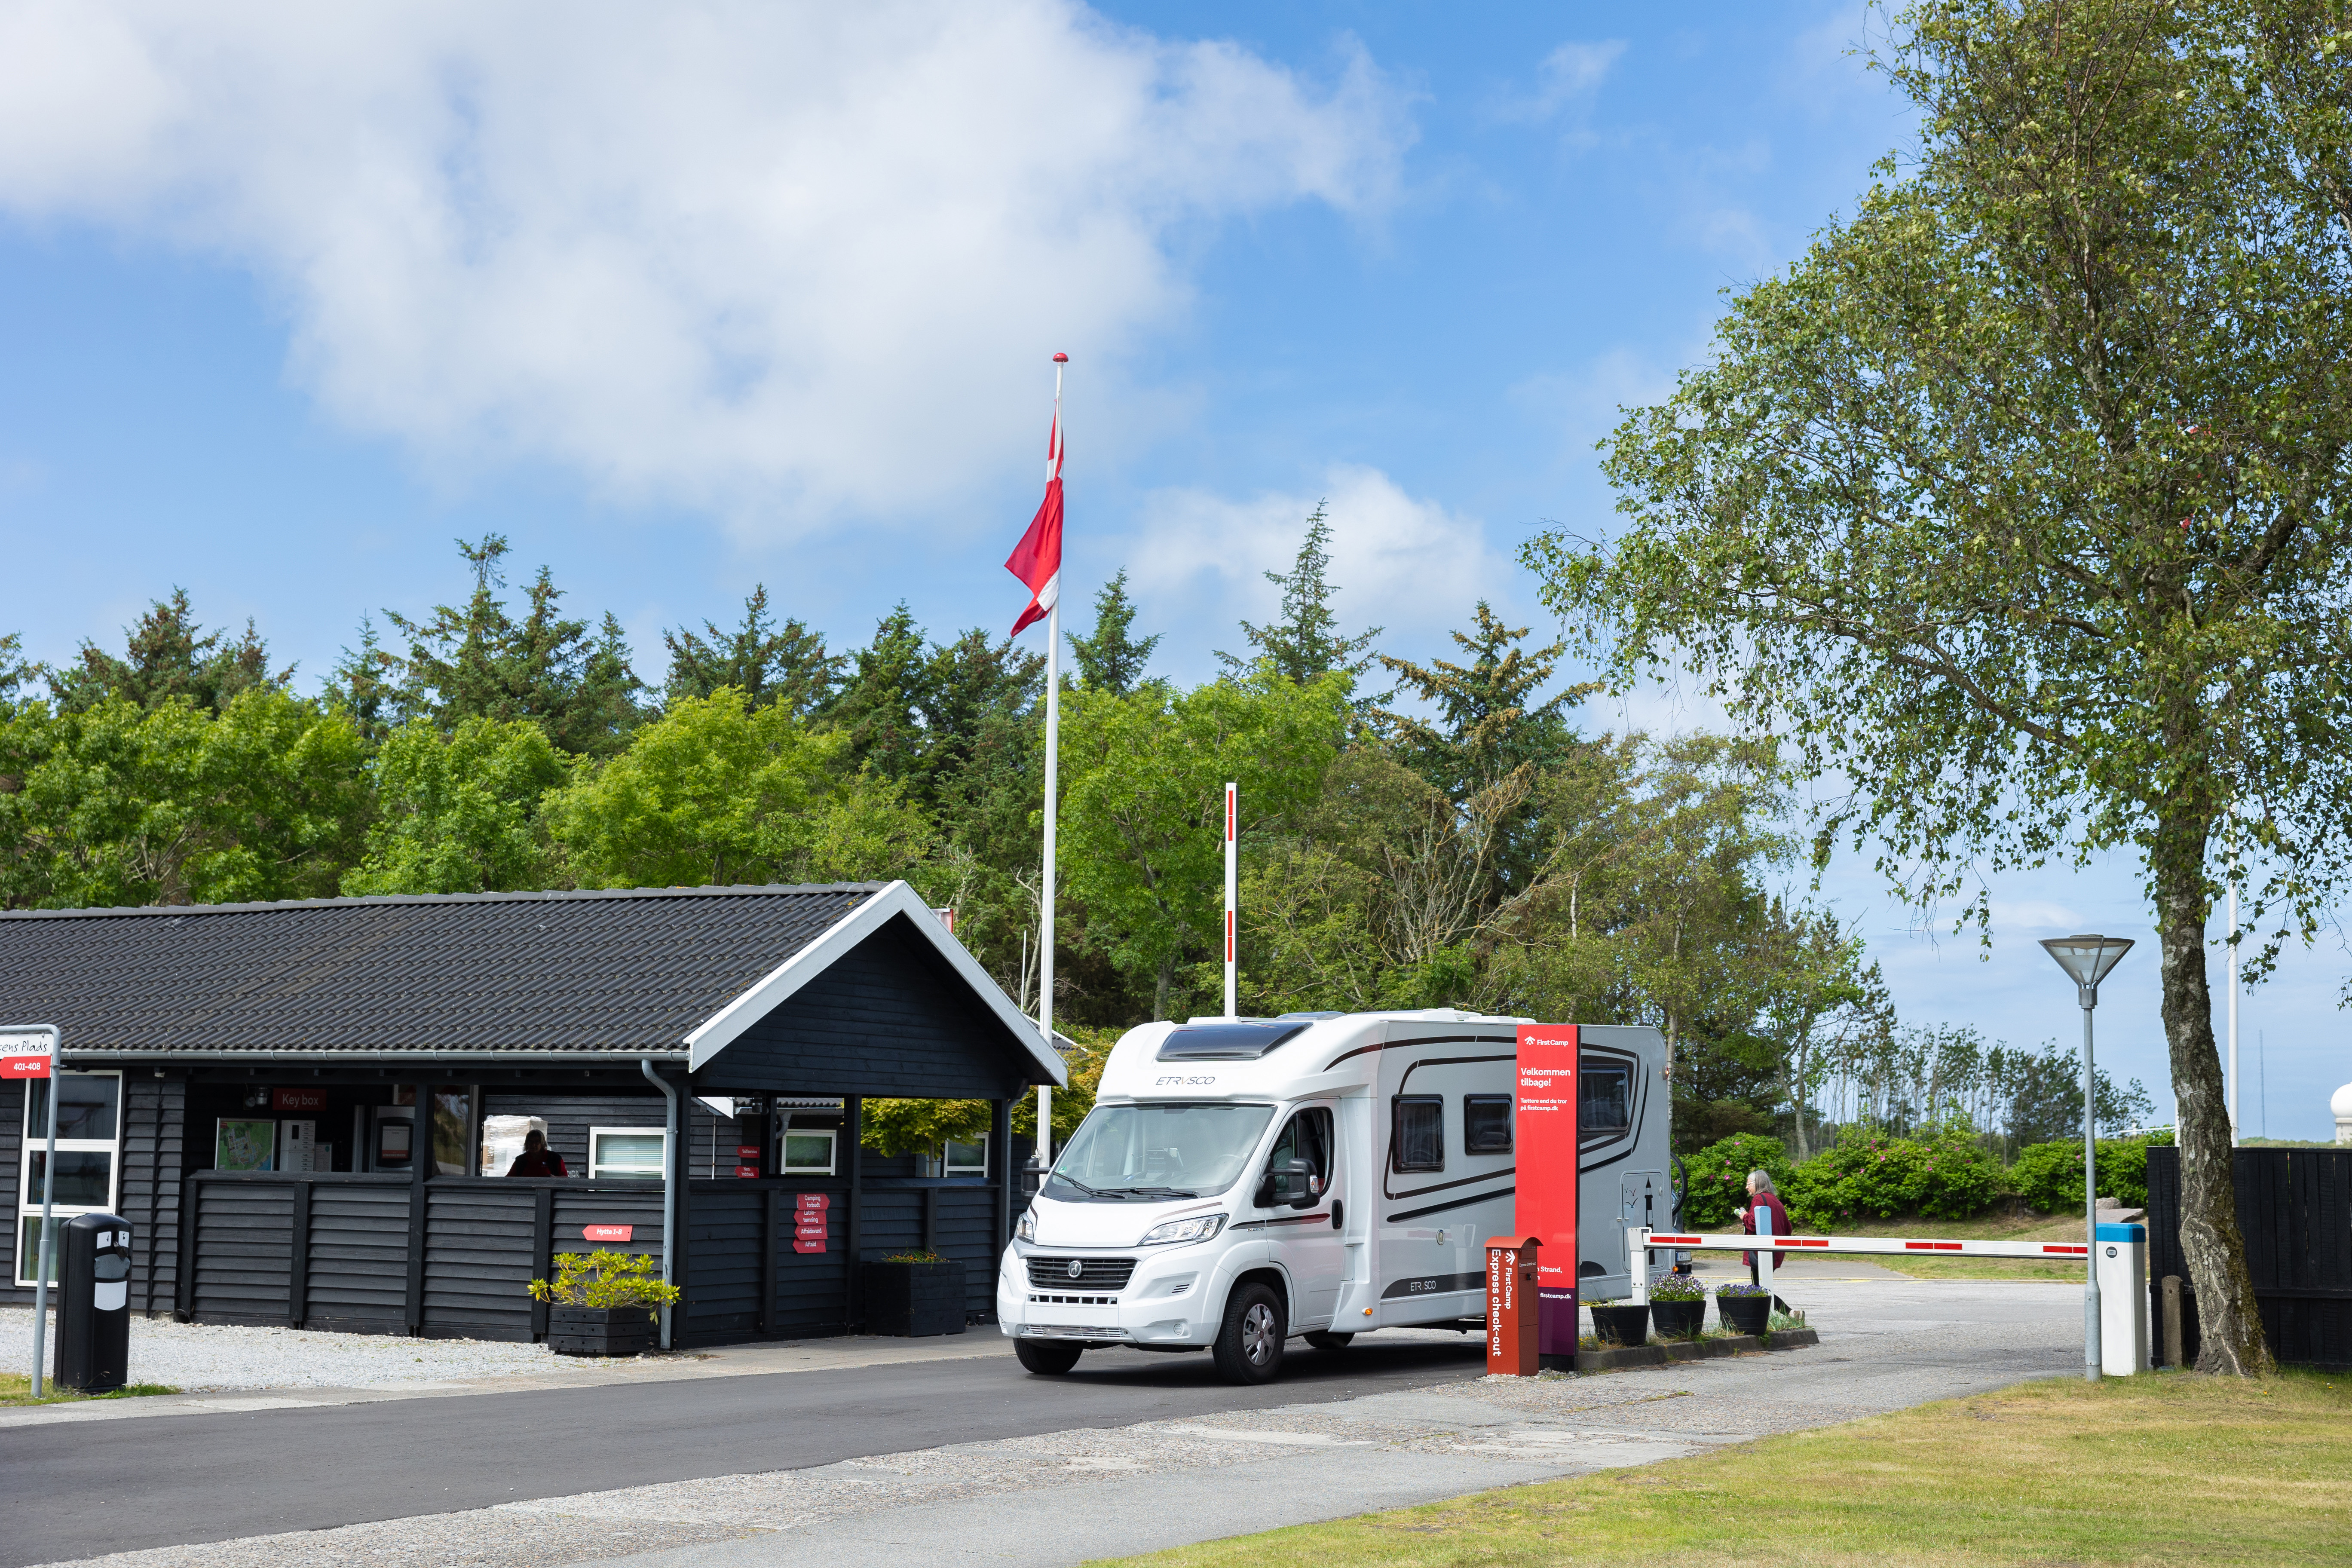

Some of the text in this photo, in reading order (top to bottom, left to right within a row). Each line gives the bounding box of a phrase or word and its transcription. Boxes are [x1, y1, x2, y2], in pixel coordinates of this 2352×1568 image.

[22, 1040, 47, 1052] Plads
[13, 1062, 41, 1071] 401-408
[1520, 1067, 1571, 1076] Velkommen
[1521, 1078, 1551, 1088] tilbage!
[282, 1093, 319, 1108] Key box
[1489, 1249, 1502, 1356] Express check-out
